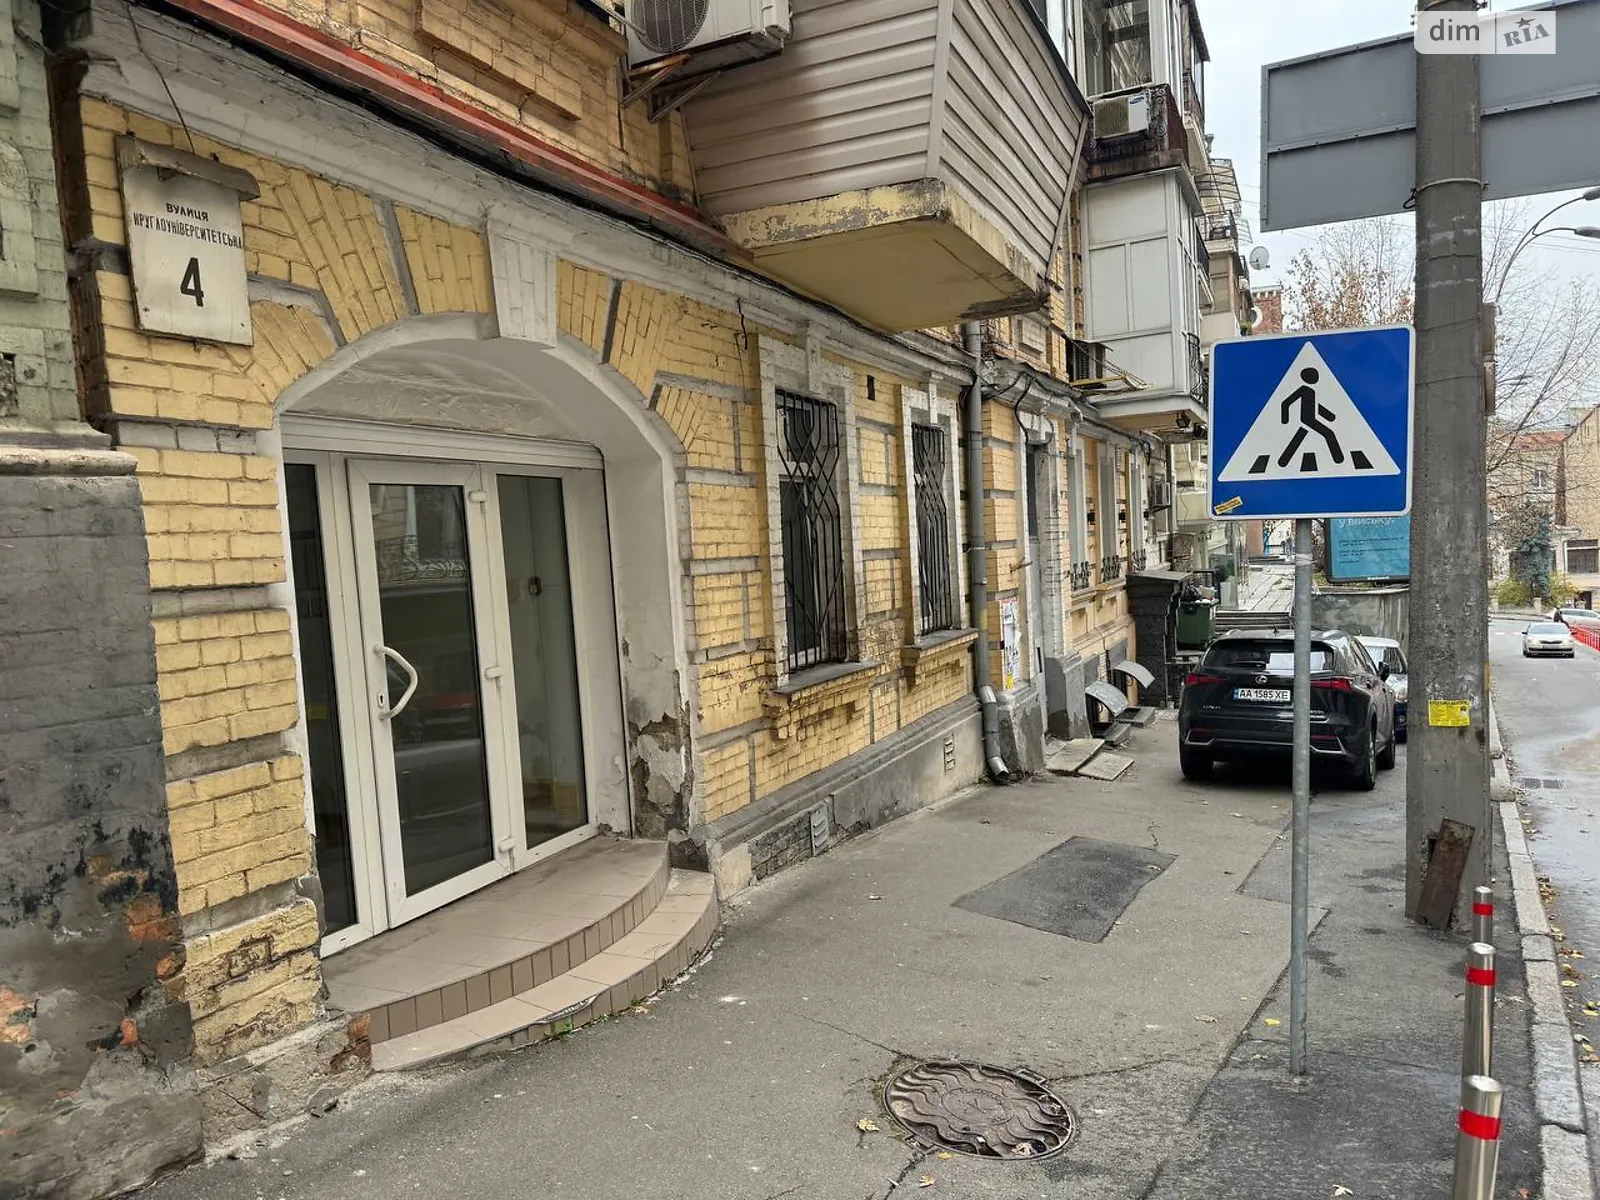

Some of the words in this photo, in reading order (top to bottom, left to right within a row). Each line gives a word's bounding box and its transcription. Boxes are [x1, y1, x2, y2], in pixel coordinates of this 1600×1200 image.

[165, 202, 209, 221] ВУЛИЦЯ
[179, 257, 205, 308] 4
[1240, 689, 1252, 699] AA
[1275, 690, 1289, 700] XE
